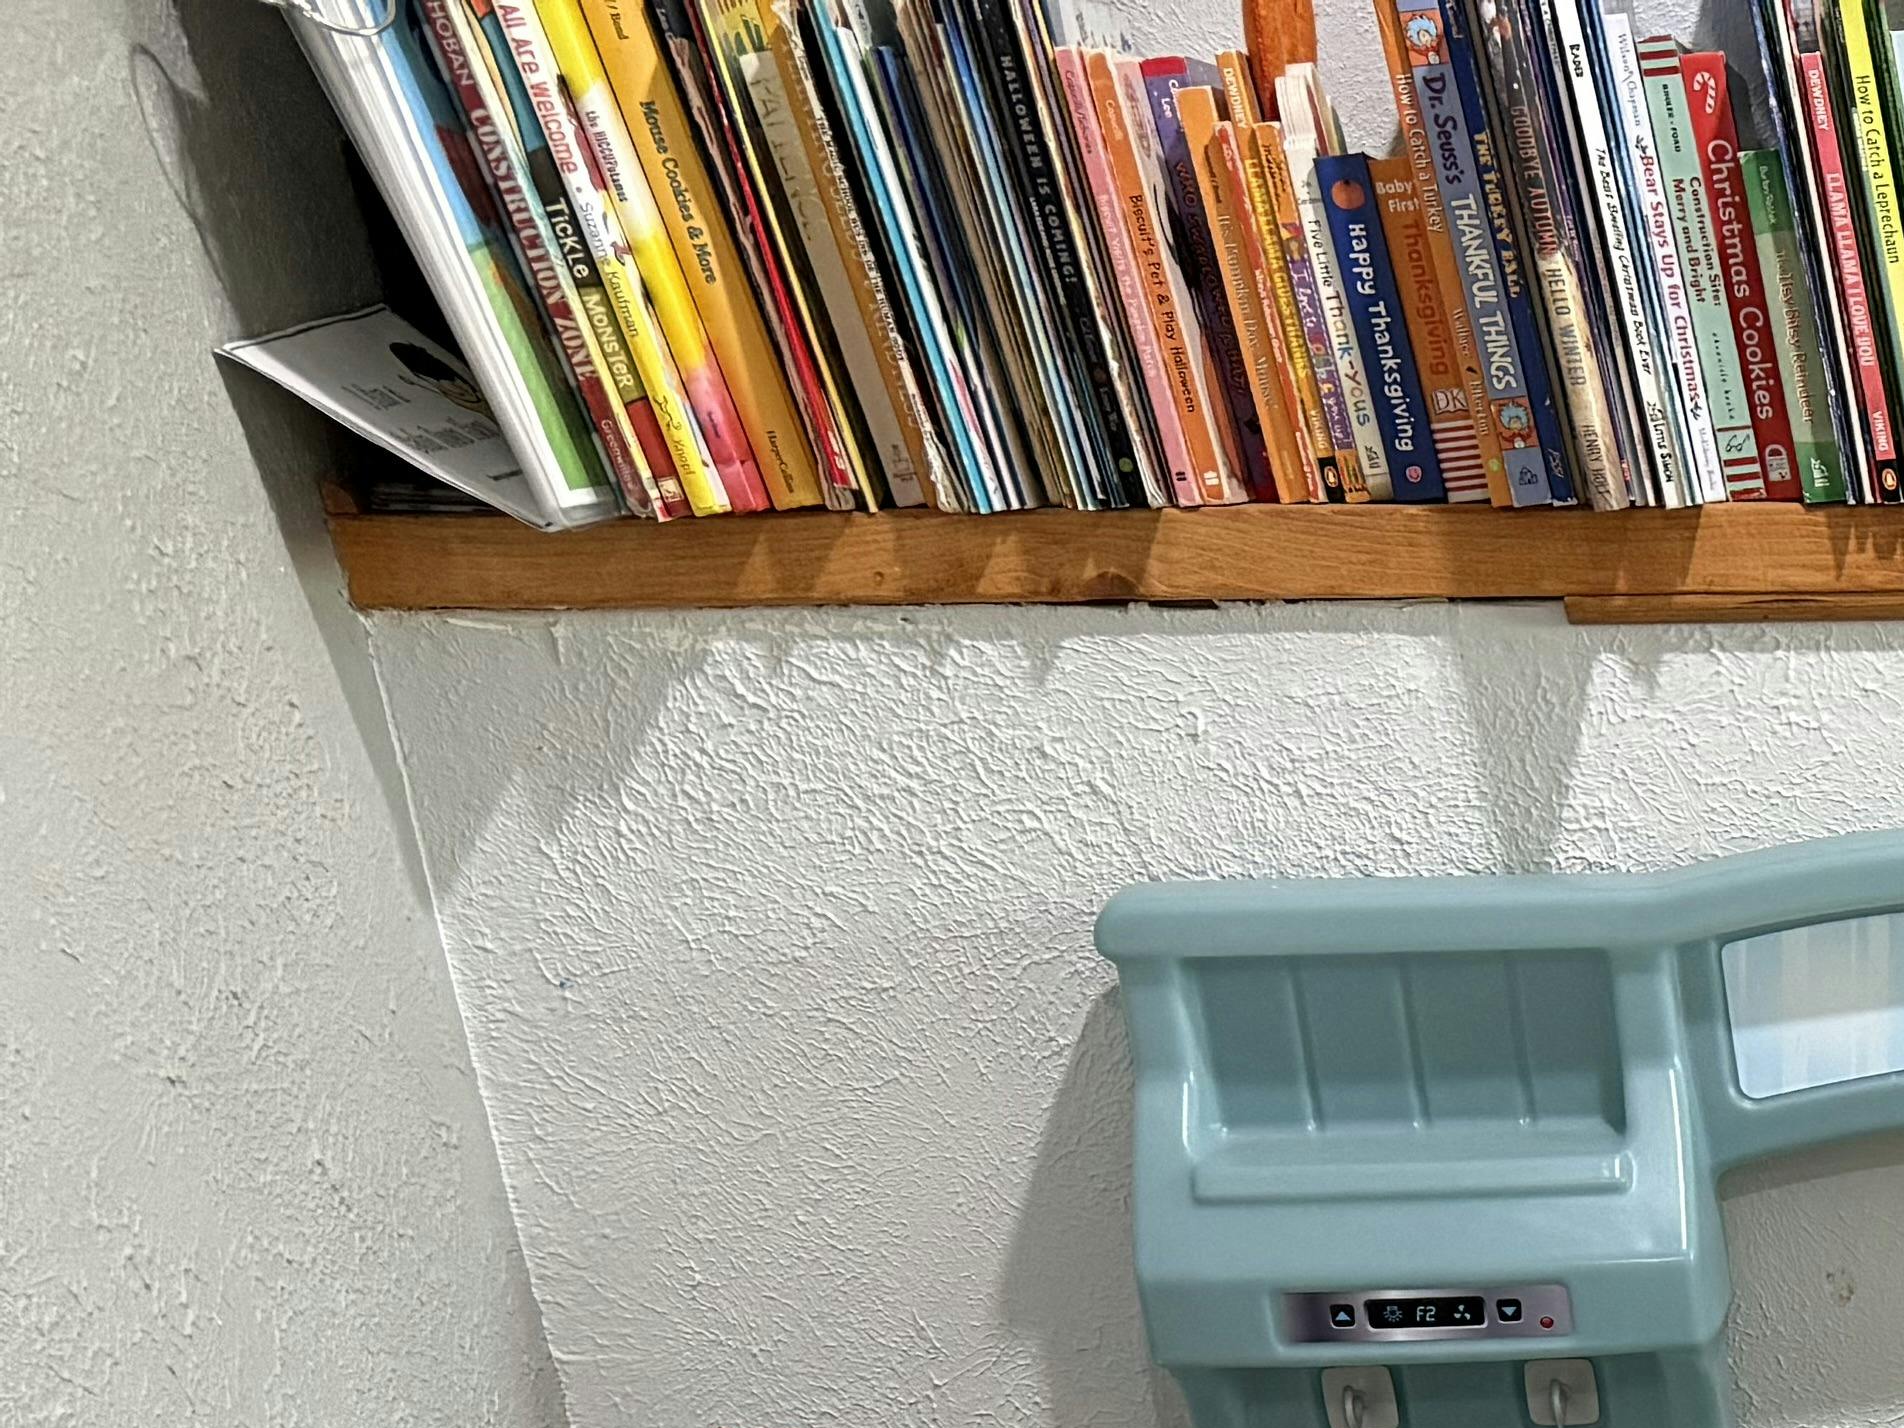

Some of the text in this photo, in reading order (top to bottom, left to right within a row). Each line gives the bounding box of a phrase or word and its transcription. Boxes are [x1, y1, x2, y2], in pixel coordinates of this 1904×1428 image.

[499, 4, 578, 176] All Are Welcome
[1396, 74, 1444, 233] How to Catch a Turkey
[1807, 69, 1829, 131] DEWDNEY
[1856, 75, 1872, 107] How
[1863, 110, 1874, 124] to
[1866, 128, 1884, 168] Catch
[470, 108, 597, 381] CONSTRUCTION ZONE
[640, 100, 717, 285] Mouse Cookies & More
[1000, 55, 1042, 169] HALLOWEEN
[1036, 177, 1049, 194] IS
[1044, 203, 1077, 283] COMING!
[1422, 73, 1517, 390] Dr. Seuss's THANKFUL THINGS
[1510, 105, 1585, 387] GOODBYE AUTUMN HELLO WINTER
[1673, 178, 1706, 303] Merry and Bright
[1872, 171, 1884, 180] a
[1875, 183, 1899, 264] Leprechaun
[579, 202, 638, 338] Suzanne Kaufman
[1129, 194, 1195, 413] Biscuit's Pet & Play Halloween
[1349, 224, 1415, 450] Happy Thanksgiving
[1402, 222, 1448, 376] Thanksgiving
[1640, 154, 1700, 403] Bear Stays Up for Christmas
[1707, 139, 1773, 420] Christmas Cookies
[1872, 411, 1889, 452] VIKING
[1416, 1306, 1437, 1322] F2
